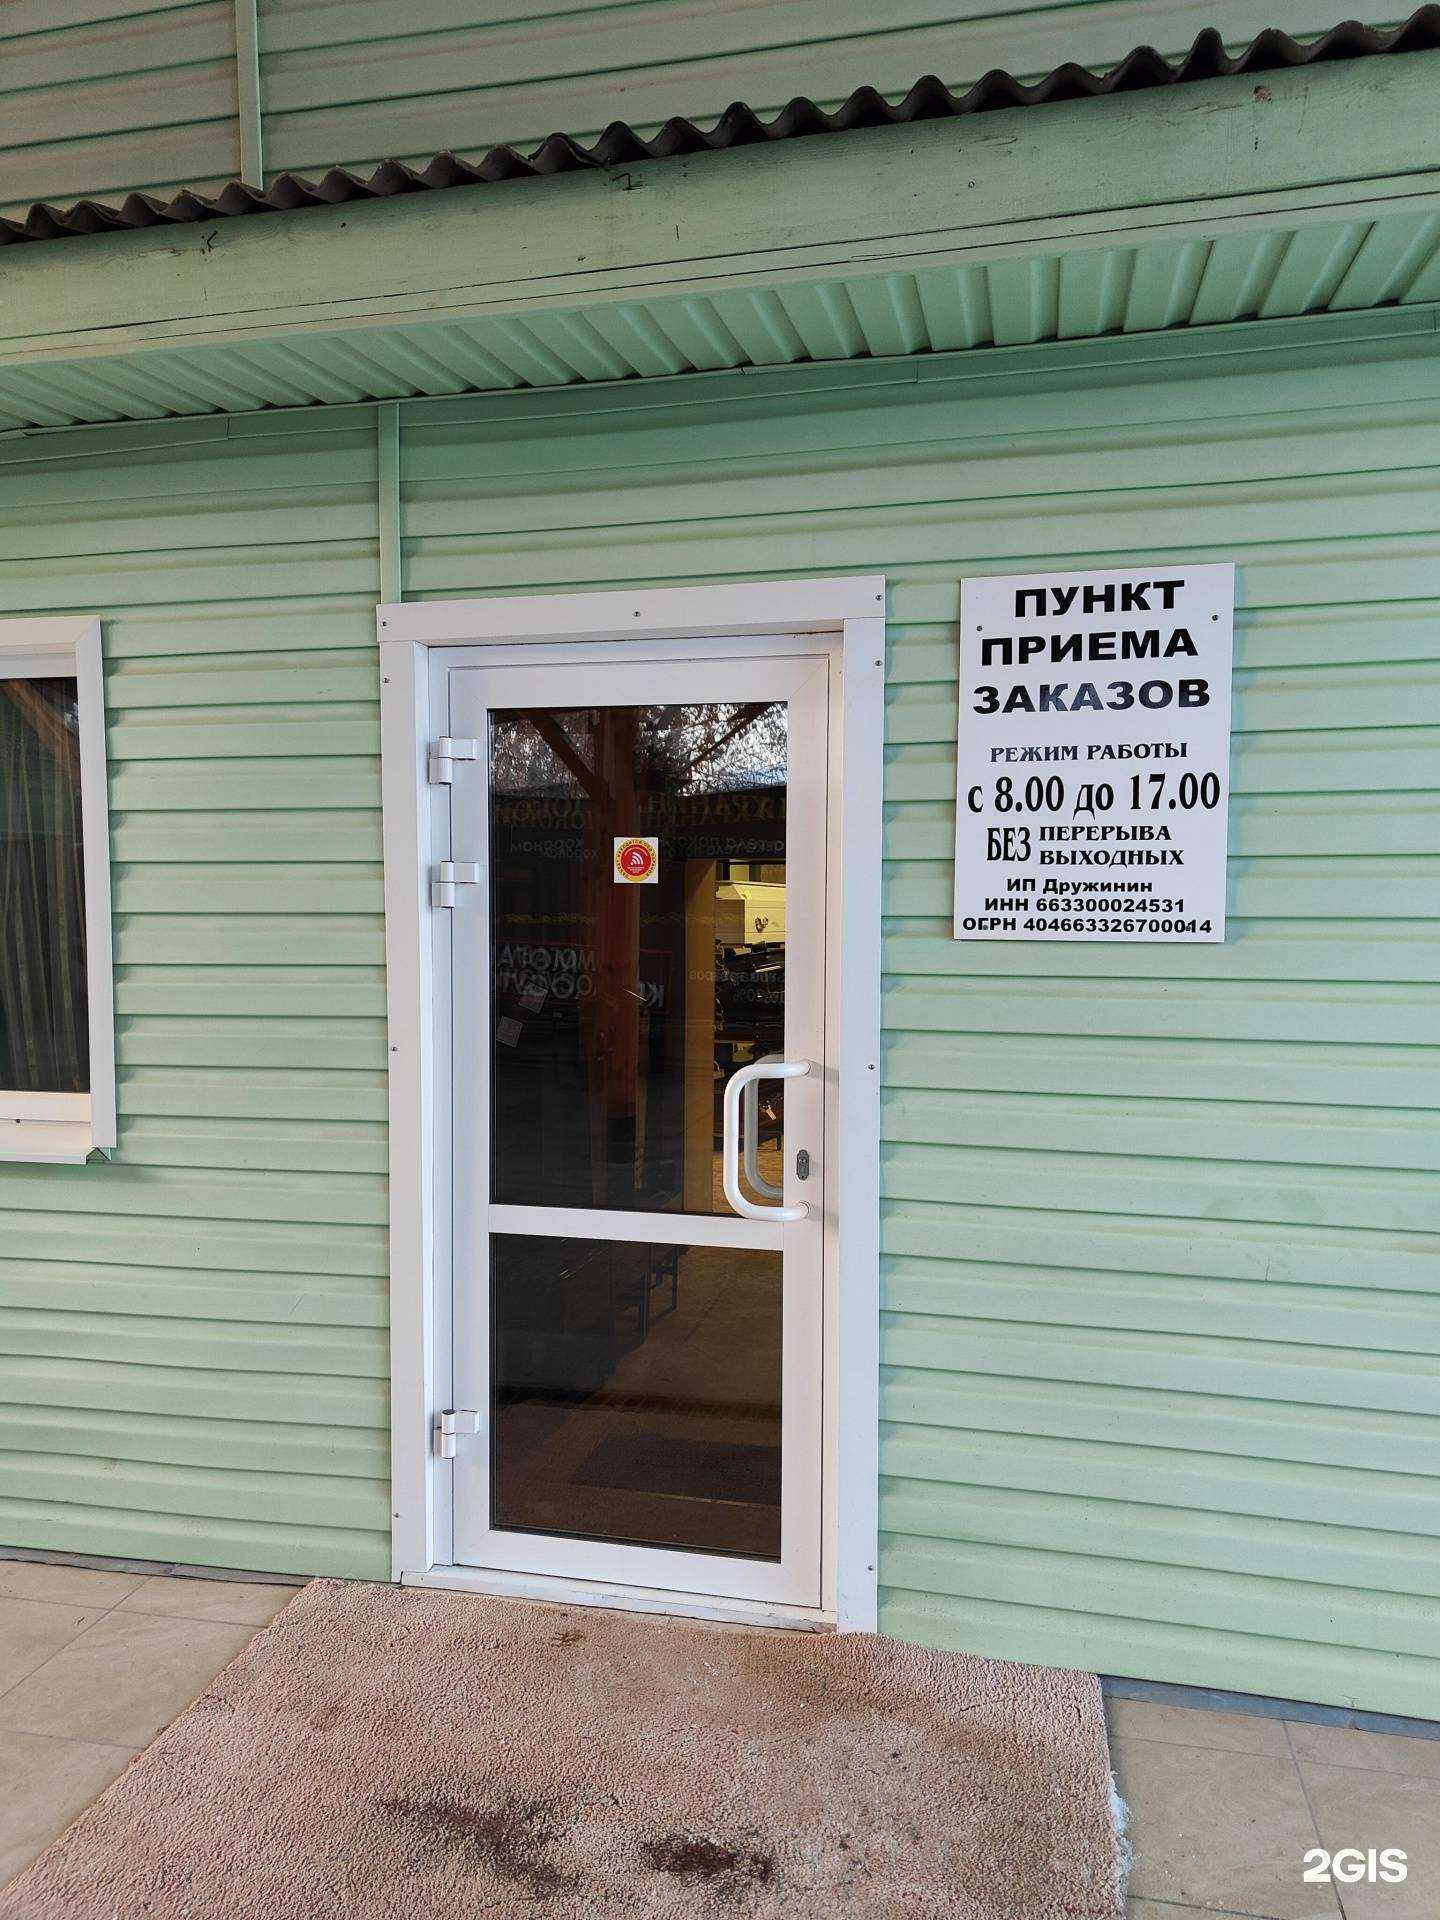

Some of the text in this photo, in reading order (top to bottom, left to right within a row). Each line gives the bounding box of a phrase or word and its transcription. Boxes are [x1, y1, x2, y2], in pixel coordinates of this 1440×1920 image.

[1015, 580, 1184, 617] ПУНКТ
[981, 628, 1198, 666] ПРИЕМА
[973, 679, 1210, 714] ЗАКАЗОВ
[991, 743, 1187, 762] РЕЖИМ РАБОТЫ
[968, 772, 1220, 820] с 8.00 до 17.00
[987, 826, 1172, 861] БЕЗ ПЕРЕРЫВА
[1040, 850, 1184, 868] ВЫХОДНЫХ
[1007, 879, 1152, 895] ИП Дружинин
[985, 898, 1183, 912] ИНН 663300024531
[963, 918, 1212, 933] ОГРН 404663326700014
